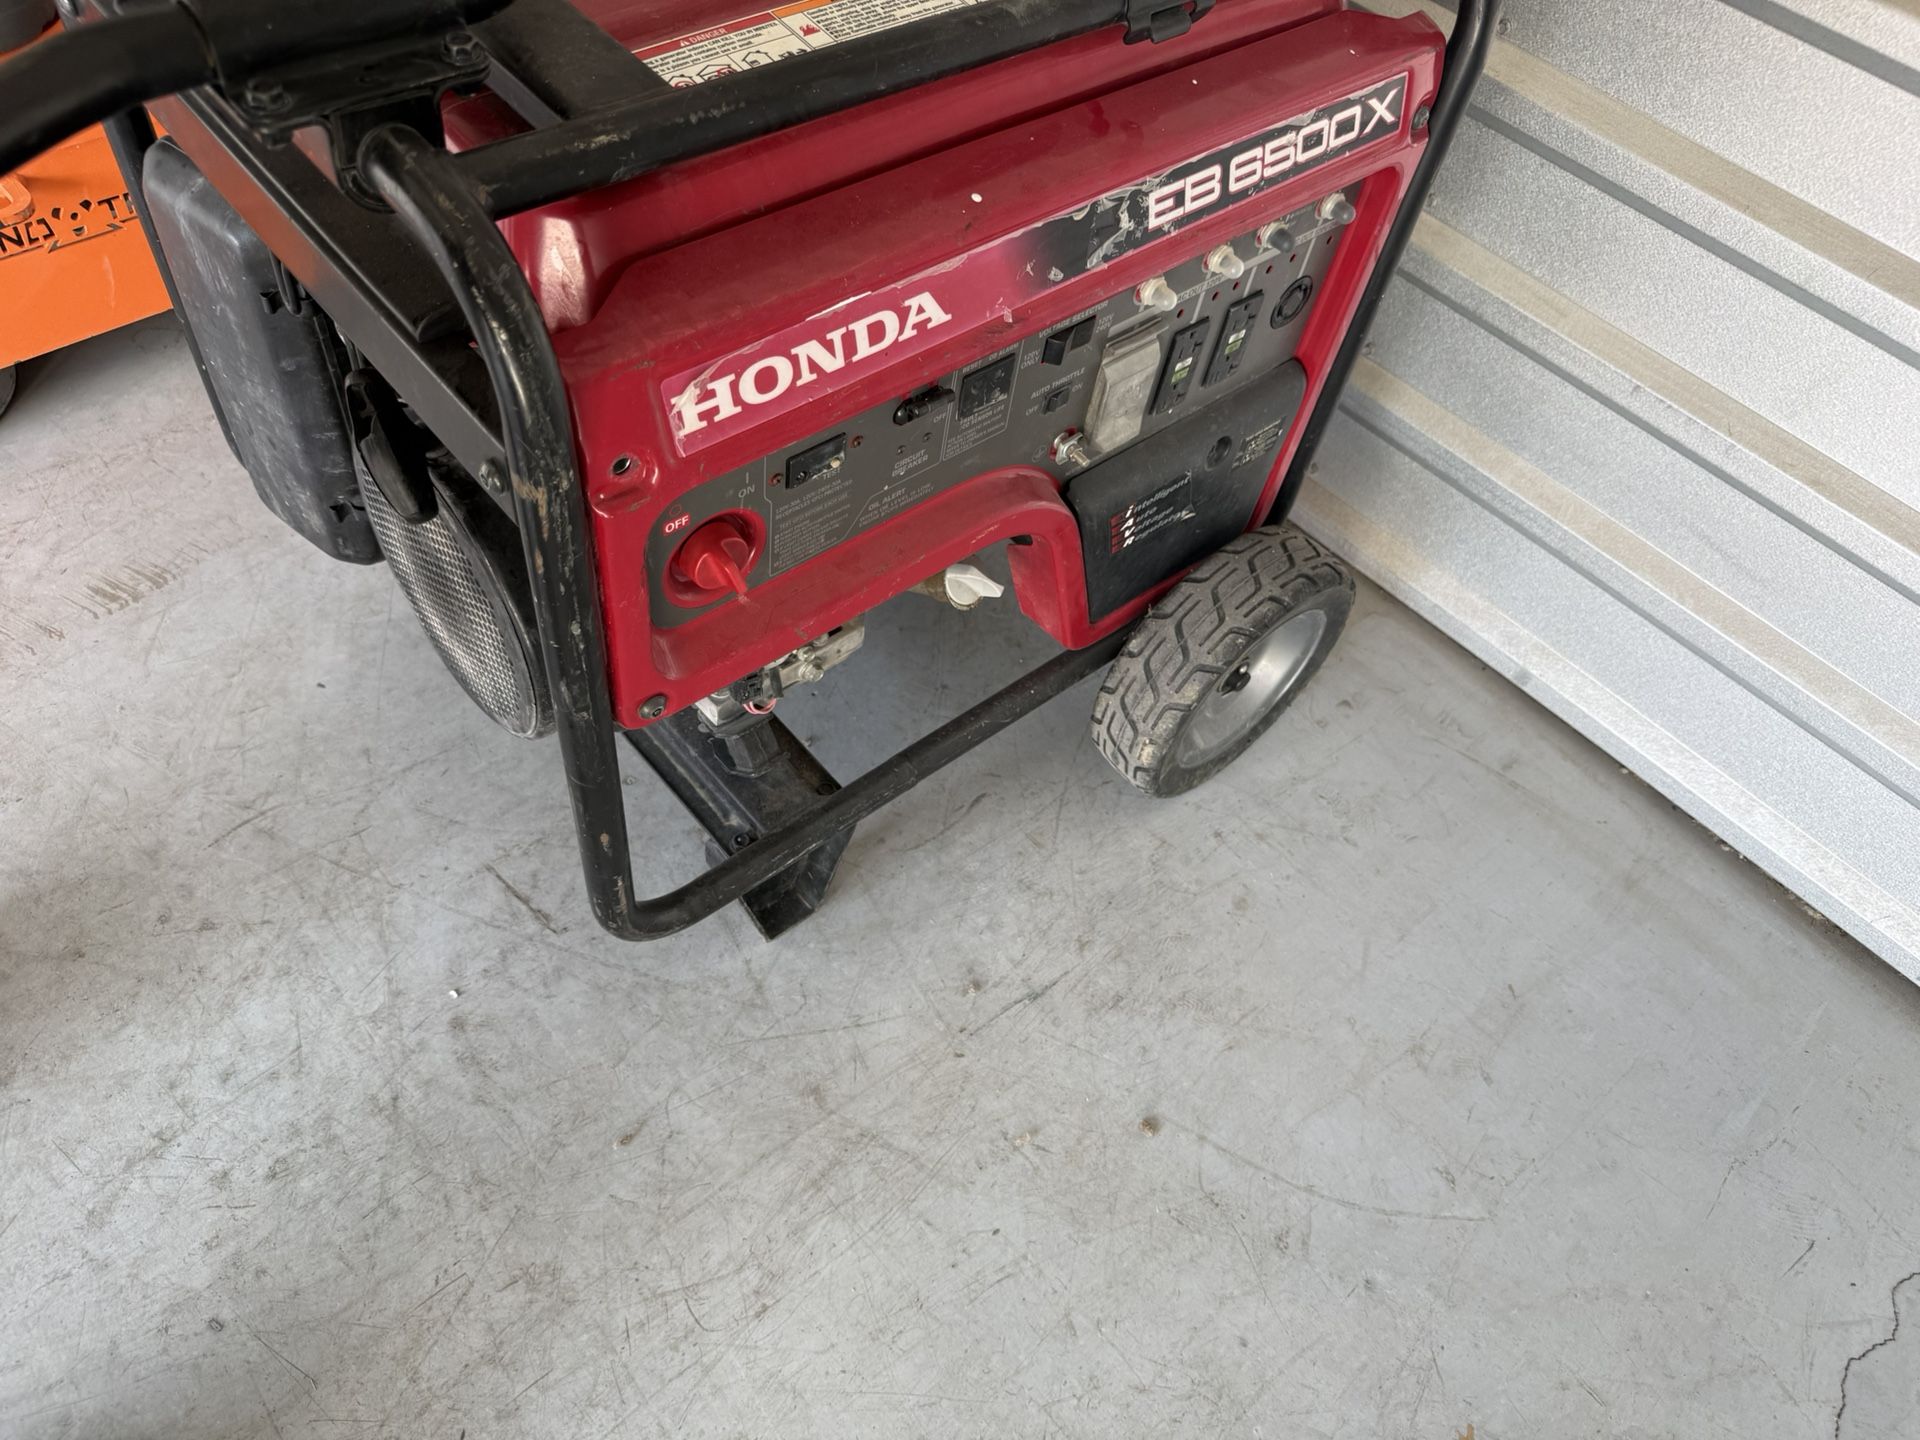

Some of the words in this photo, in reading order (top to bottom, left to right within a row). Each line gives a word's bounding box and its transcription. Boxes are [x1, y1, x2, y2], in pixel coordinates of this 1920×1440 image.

[687, 27, 728, 43] DANGER
[731, 30, 747, 38] YOU
[1147, 160, 1222, 233] EB
[1228, 86, 1401, 194] 6500X
[672, 291, 952, 436] HONDA
[1031, 384, 1051, 400] AUTO
[1052, 367, 1085, 388] THROTTLE
[894, 448, 927, 469] CIRCUIT
[738, 484, 755, 498] ON
[882, 487, 906, 504] ALERT
[664, 515, 689, 533] OFF
[1120, 506, 1158, 531] Auto
[1124, 506, 1174, 538] Voltage
